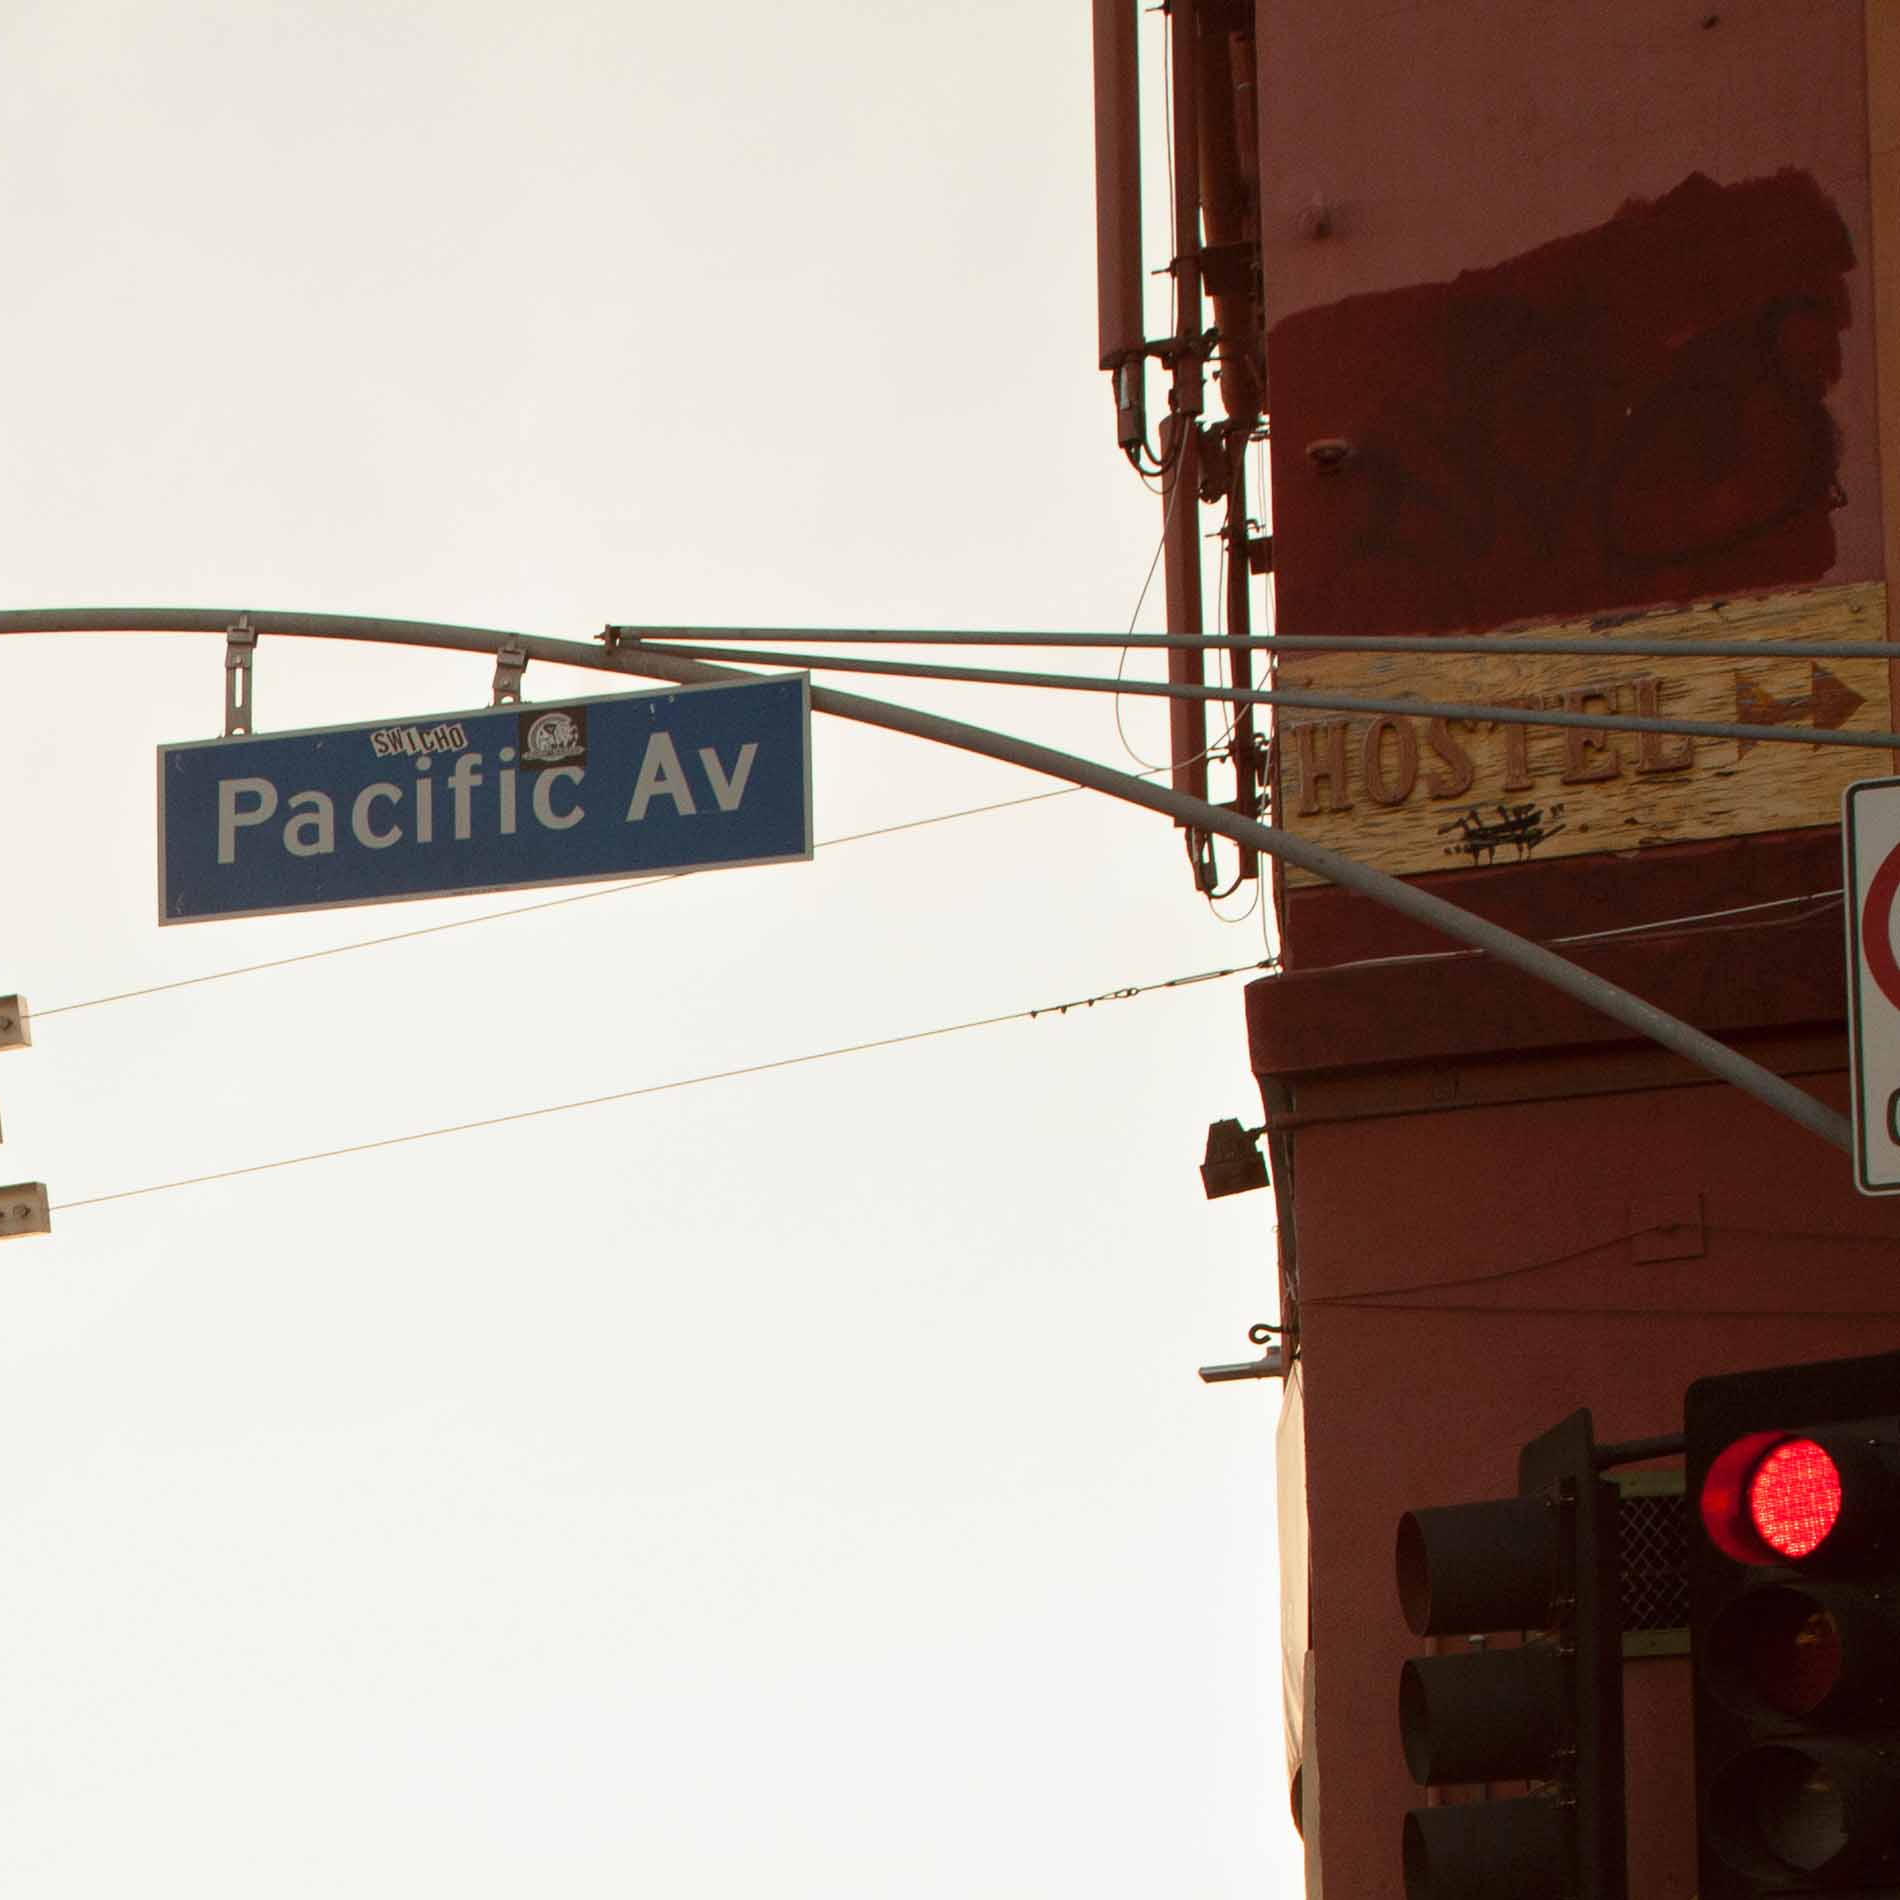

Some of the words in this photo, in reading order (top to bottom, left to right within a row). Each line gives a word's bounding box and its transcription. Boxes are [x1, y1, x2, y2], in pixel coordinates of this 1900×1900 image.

[216, 746, 587, 866] Pacific
[625, 730, 760, 823] Av
[1293, 677, 1695, 817] HOSTEL
